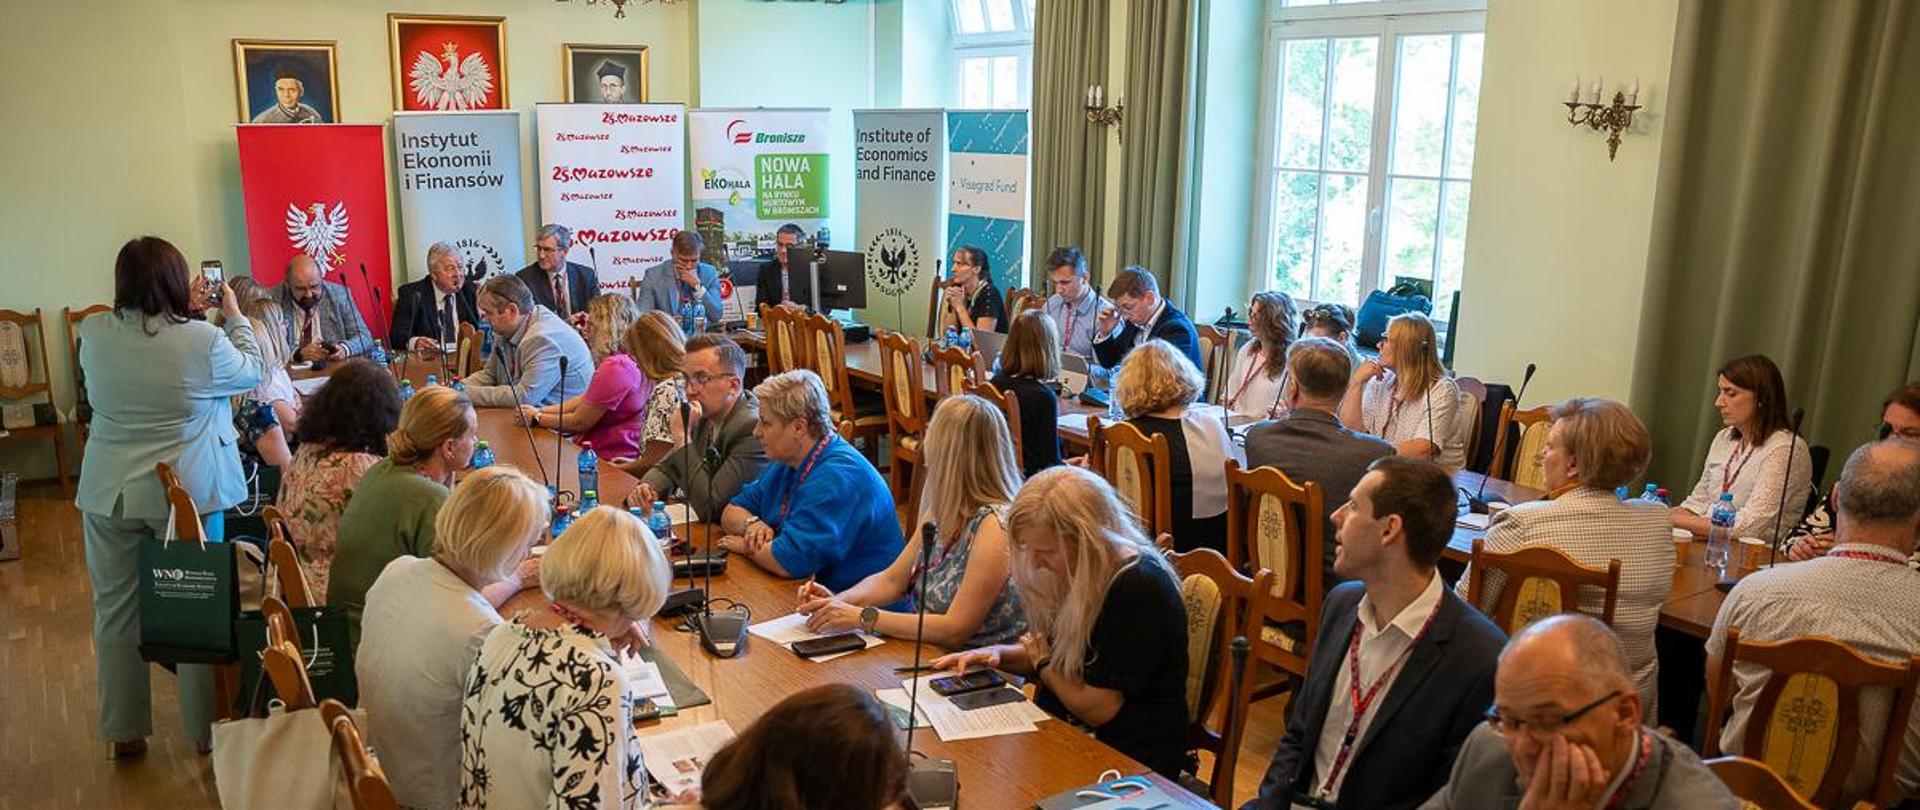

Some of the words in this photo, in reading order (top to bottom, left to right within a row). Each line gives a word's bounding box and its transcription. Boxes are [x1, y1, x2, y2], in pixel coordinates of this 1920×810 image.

[402, 132, 478, 151] Instytut
[755, 132, 806, 143] Bronisze
[856, 128, 914, 143] Institute
[917, 127, 931, 143] of
[404, 150, 491, 169] Ekonomii
[856, 147, 928, 162] Economics
[761, 157, 811, 173] NOWA
[405, 173, 410, 190] i
[415, 170, 504, 190] Finansów
[762, 173, 804, 189] HALA
[856, 165, 880, 180] and
[883, 165, 936, 182] Finance
[960, 178, 995, 194] Visegrad
[996, 179, 1017, 193] Fund
